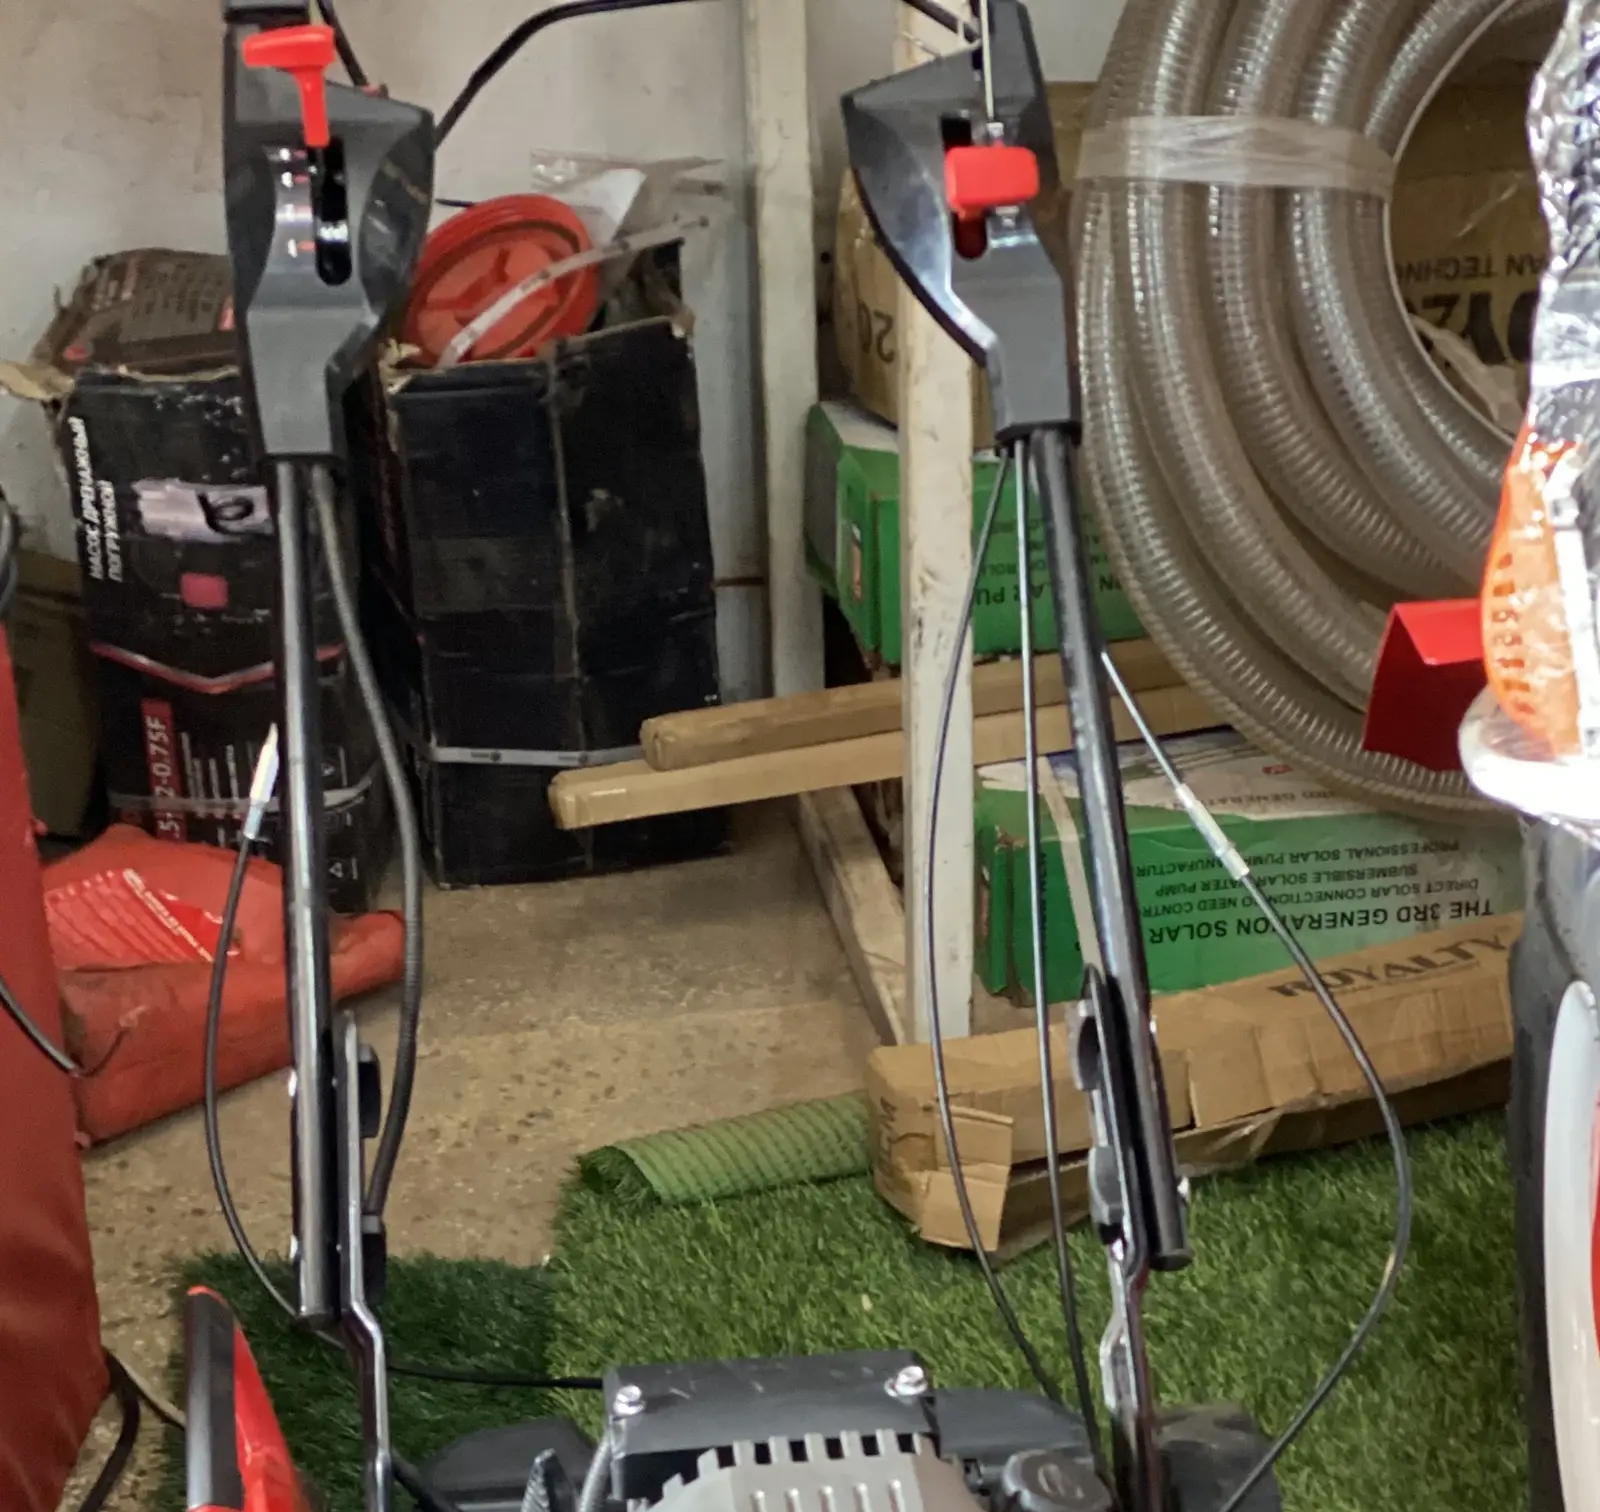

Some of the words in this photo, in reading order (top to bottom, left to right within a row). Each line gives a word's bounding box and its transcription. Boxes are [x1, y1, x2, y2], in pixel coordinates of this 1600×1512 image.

[1396, 256, 1497, 283] TECHN
[1290, 849, 1341, 865] SOLAR
[1344, 840, 1460, 860] PROFESSIONAL
[1135, 859, 1224, 878] ANUFACTUR
[1312, 864, 1418, 884] SUBMERSIBLE
[1155, 883, 1197, 897] PUMP
[1255, 873, 1308, 888] SOLAR
[1426, 878, 1479, 895] DIRECT
[1370, 883, 1421, 899] SOLAR
[1140, 900, 1194, 919] CONTR
[1198, 896, 1238, 911] NEED
[1450, 899, 1494, 919] THE
[1236, 908, 1389, 937] GENERAON
[1396, 903, 1441, 925] 3RD
[1147, 919, 1228, 945] SOLAR
